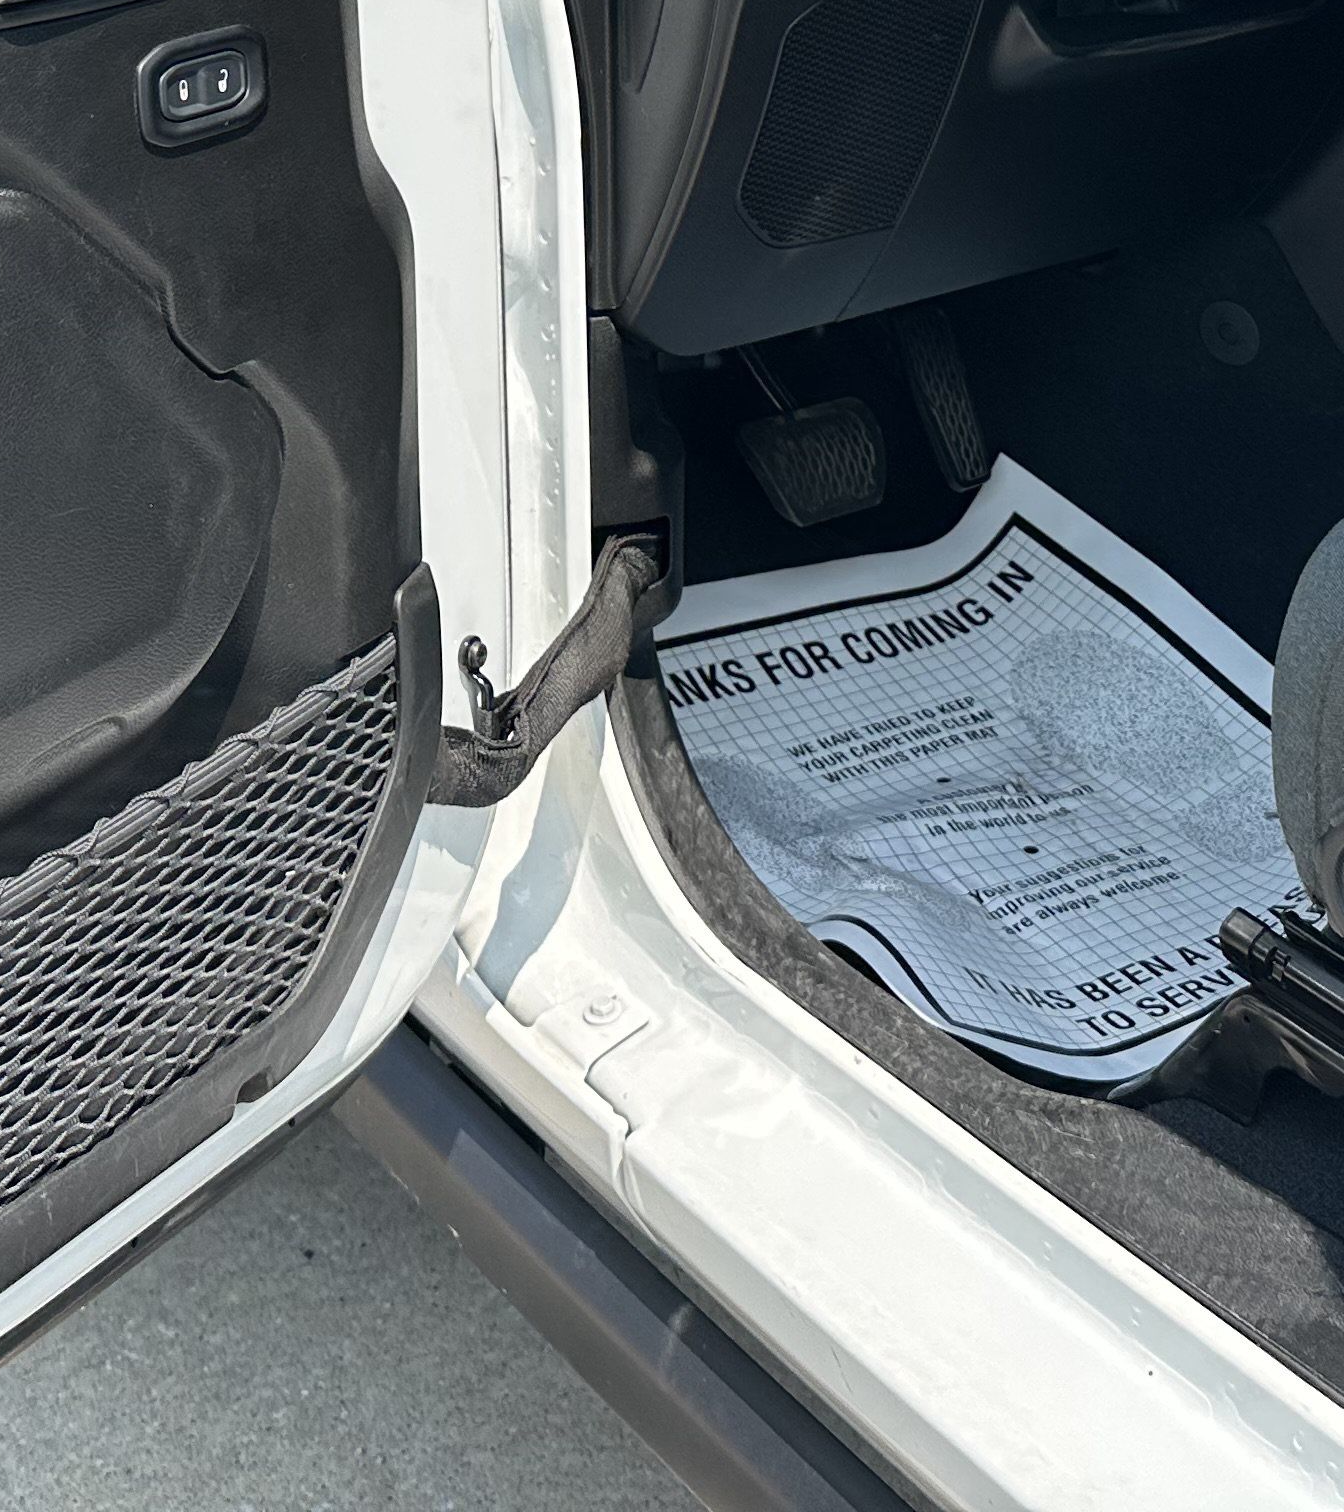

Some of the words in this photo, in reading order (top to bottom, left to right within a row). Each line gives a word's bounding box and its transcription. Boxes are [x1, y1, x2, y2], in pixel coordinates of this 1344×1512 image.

[756, 640, 844, 686] FOR
[840, 597, 996, 665] COMING
[986, 560, 1035, 604] IN
[787, 741, 818, 759] WE
[816, 727, 860, 750] HAVE
[862, 714, 912, 737] TRIED
[911, 707, 937, 722] TO
[935, 695, 976, 715] KEEP
[799, 749, 850, 774] YOUR
[849, 723, 942, 759] CARPETING
[940, 708, 996, 730] CLEAN
[821, 763, 870, 784] WITH
[868, 749, 911, 771] THIS
[908, 733, 966, 758] PAPER
[963, 725, 1000, 742] MAT
[909, 802, 956, 820] most
[946, 818, 978, 833] the
[978, 810, 1028, 830] world
[1027, 810, 1048, 825] to
[968, 882, 1014, 906] Your
[1014, 853, 1121, 890] suggestions
[1074, 871, 1106, 889] our
[1105, 855, 1172, 879] service
[1002, 915, 1035, 936] are
[1034, 893, 1101, 921] always
[962, 965, 998, 995] IT
[999, 978, 1077, 1011] HAS
[1075, 954, 1178, 1003] BEEN
[1176, 945, 1209, 966] A
[1075, 1009, 1137, 1038] TO
[1134, 964, 1238, 1019] SERV
